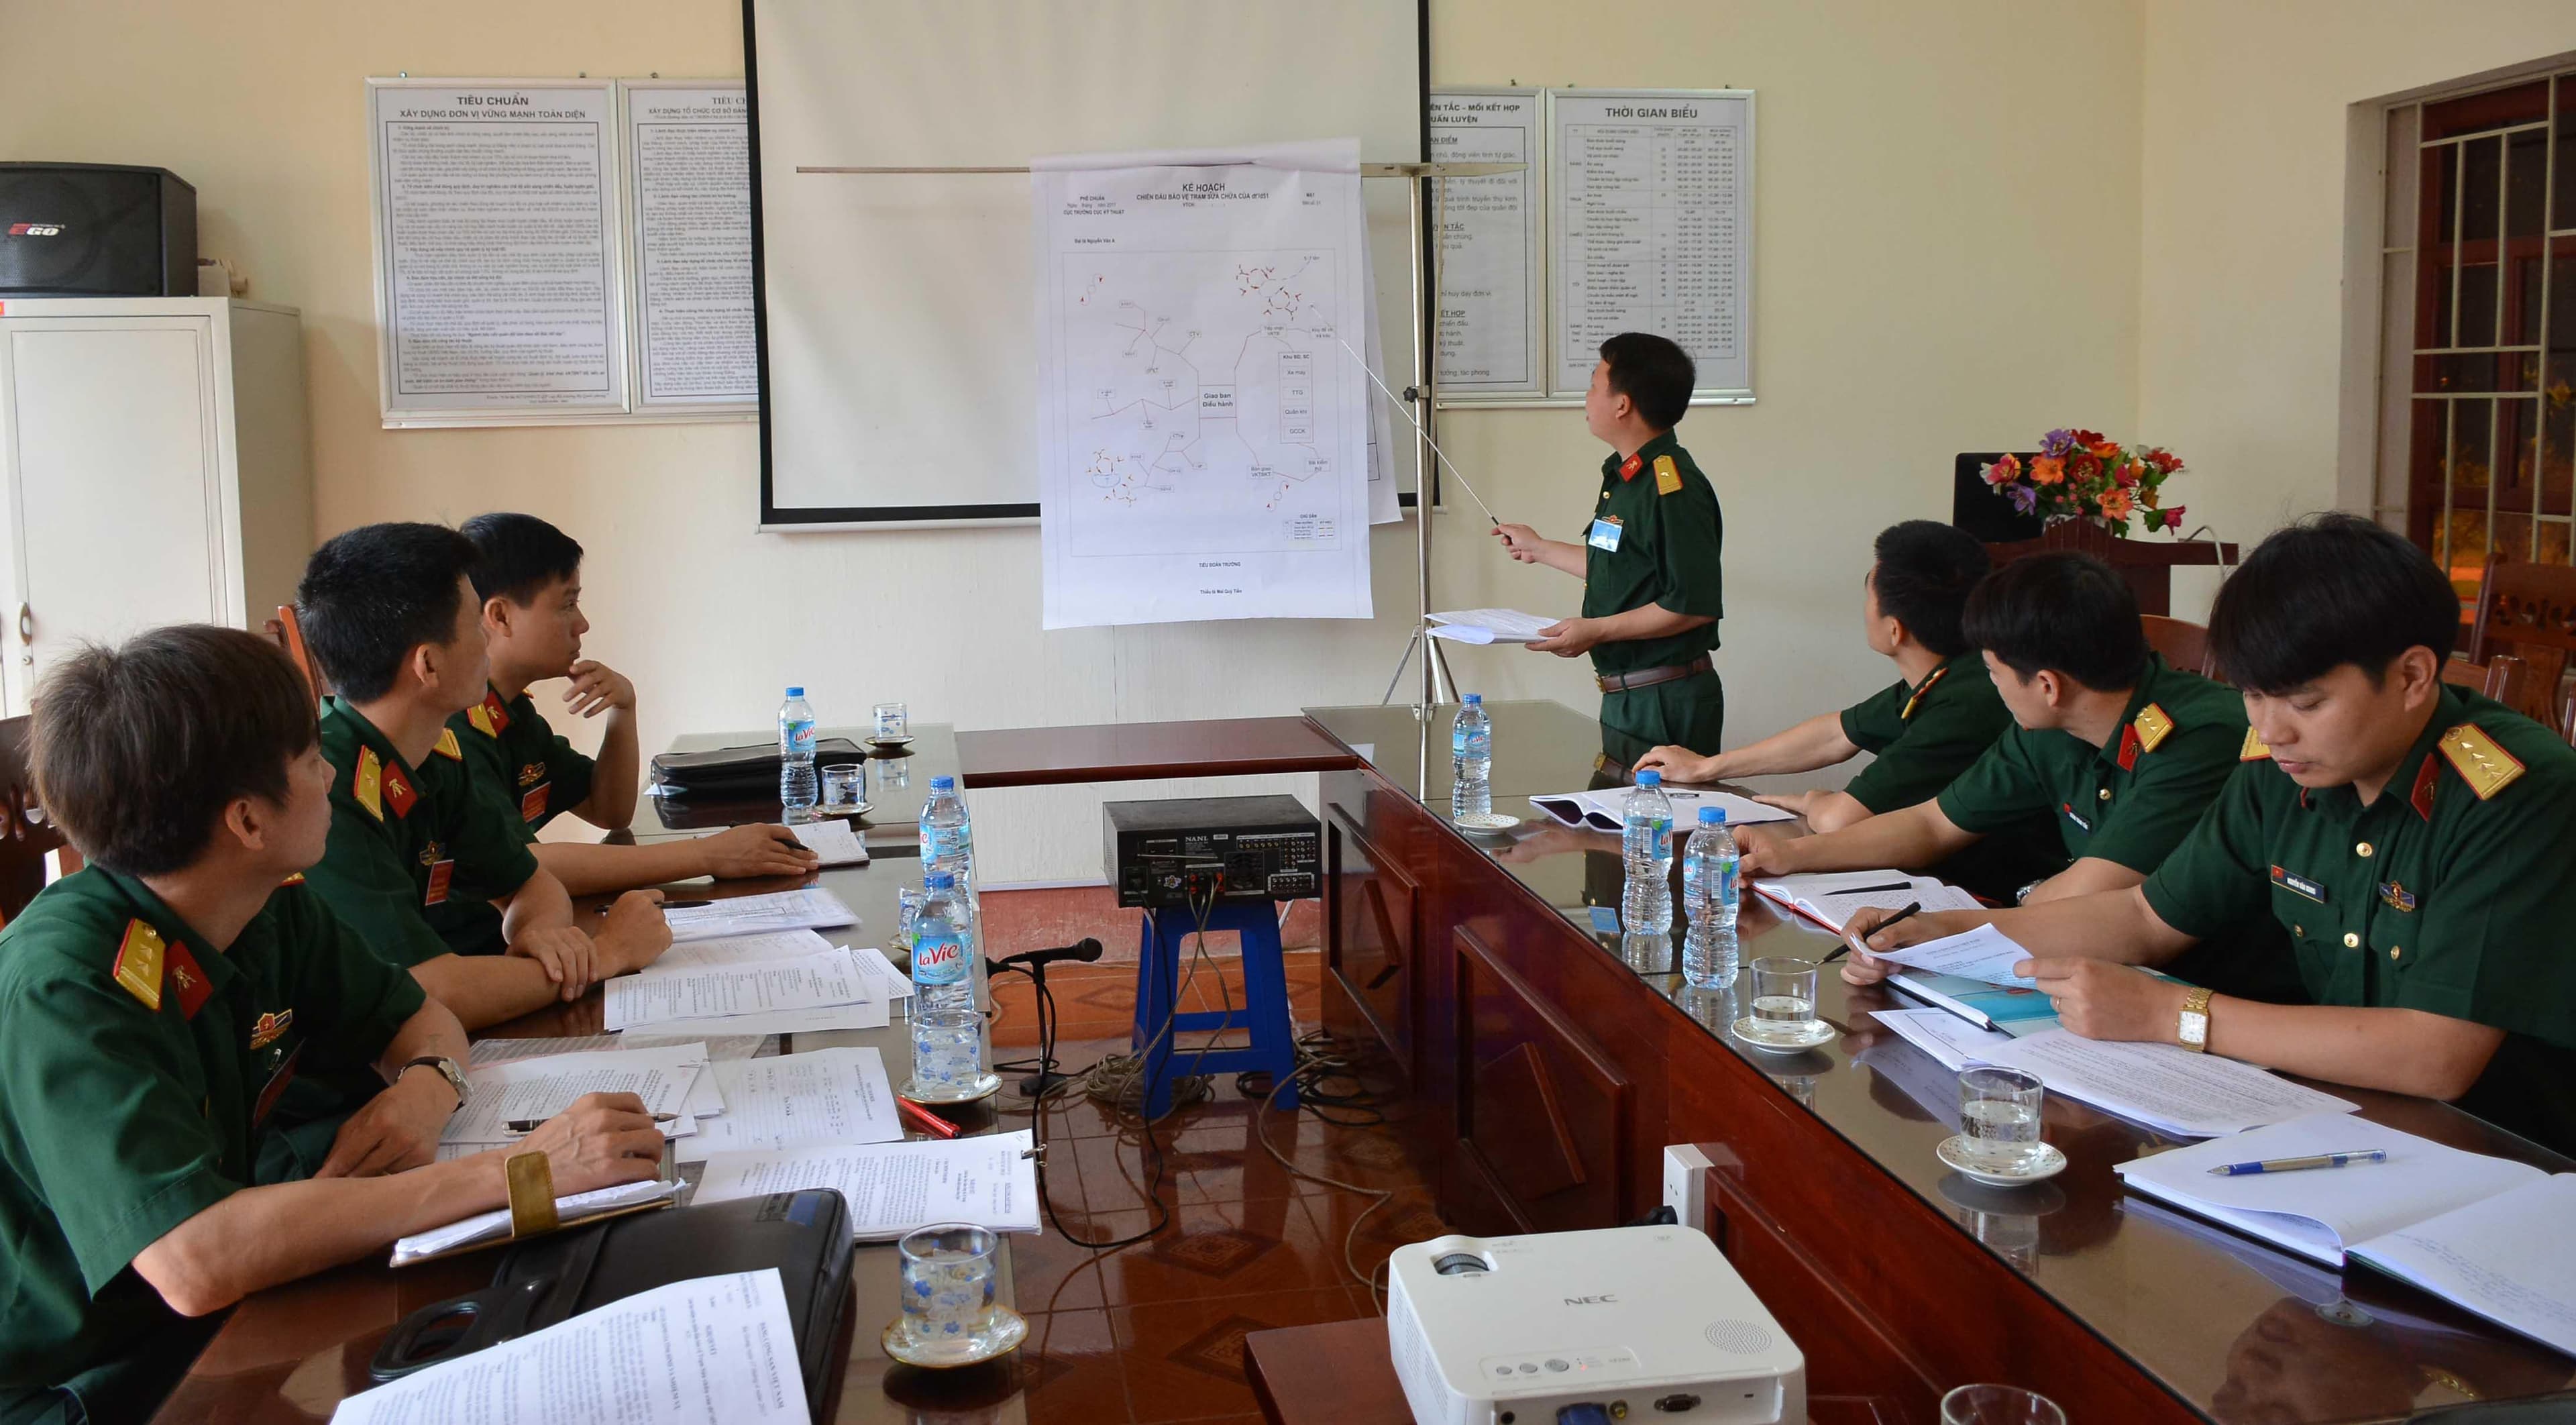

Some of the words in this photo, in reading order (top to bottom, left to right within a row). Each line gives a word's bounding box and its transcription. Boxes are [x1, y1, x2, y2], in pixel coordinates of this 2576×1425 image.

[457, 95, 483, 105] TIÊU
[487, 92, 529, 105] CHUẨN
[1443, 101, 1460, 111] TẮC
[1605, 105, 1633, 118] THỜI
[1637, 108, 1667, 118] GIAN
[1671, 103, 1698, 119] BIỂU
[400, 109, 419, 118] XÂY
[421, 109, 446, 119] DỰNG
[449, 109, 468, 118] ĐƠN
[509, 111, 535, 119] MẠNH
[1195, 182, 1226, 194] HOẠCH
[9, 223, 60, 235] EGO
[1564, 1294, 1619, 1306] NEC
